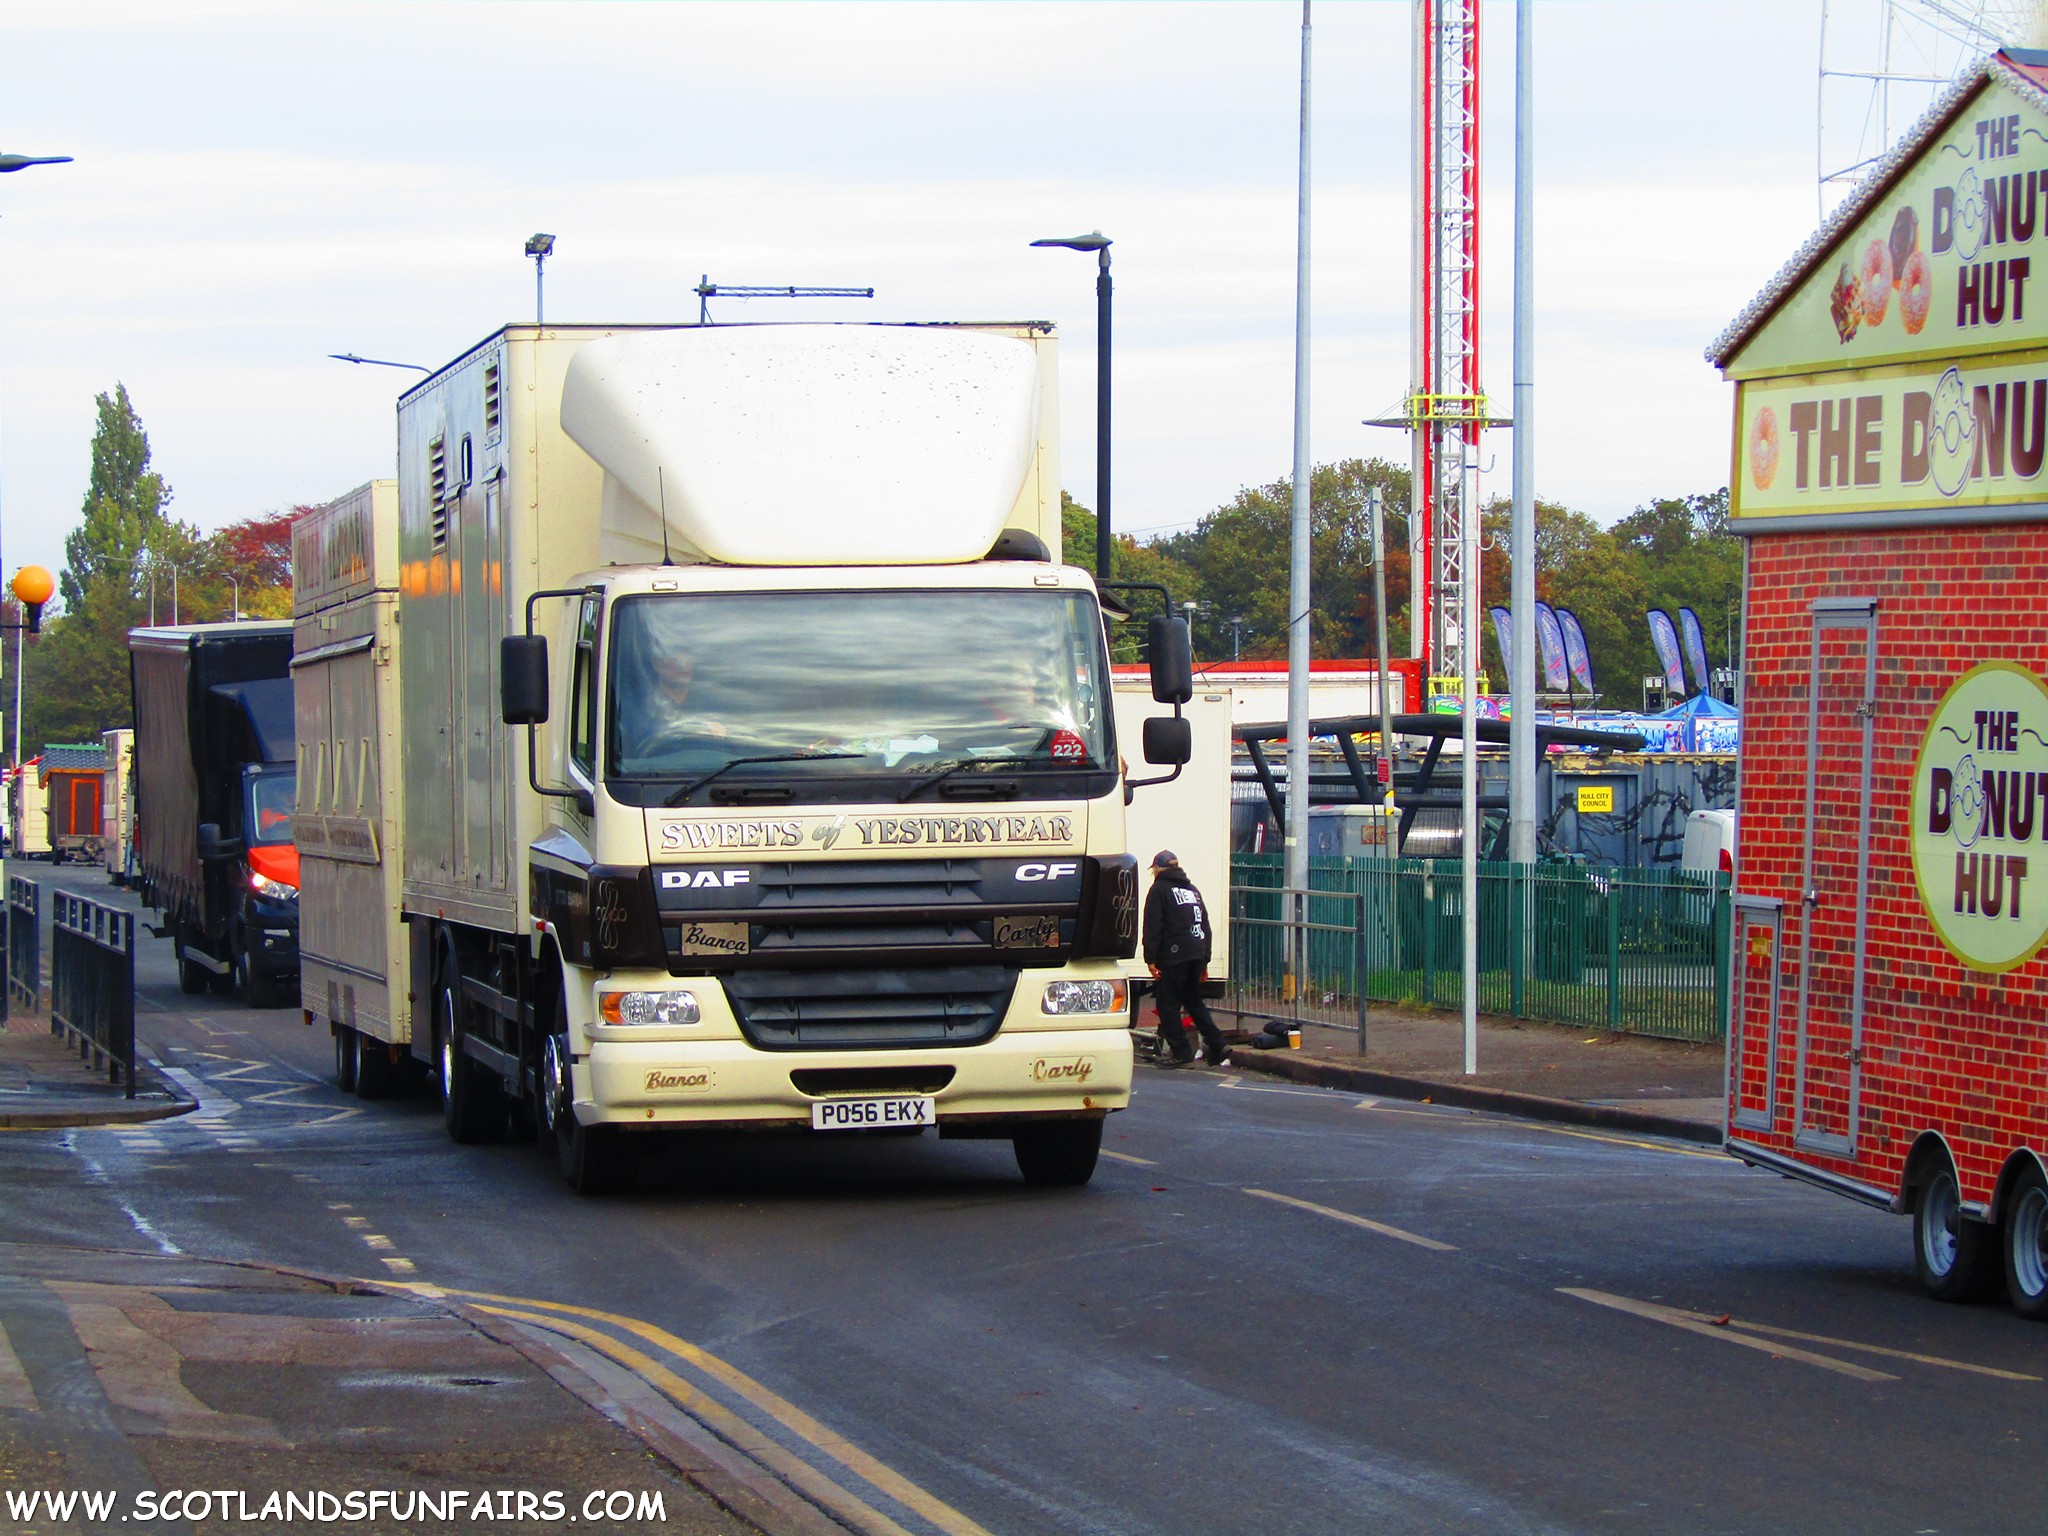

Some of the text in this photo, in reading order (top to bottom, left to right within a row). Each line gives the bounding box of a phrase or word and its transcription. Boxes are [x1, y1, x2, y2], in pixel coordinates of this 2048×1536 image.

[1975, 113, 2020, 161] THE
[1956, 256, 2031, 329] HUT
[1789, 394, 1884, 491] THE
[1973, 710, 2019, 753] THE
[1053, 744, 1082, 757] 222
[1596, 792, 1609, 800] CITY
[661, 815, 1074, 850] SWEETS of YESTERYEAR
[661, 870, 750, 888] DAF
[1014, 863, 1077, 882] CF
[1953, 851, 2028, 920] HUT
[685, 926, 747, 951] Bianca
[997, 916, 1056, 943] Carly
[646, 1070, 709, 1089] Bianca
[1034, 1057, 1093, 1083] Carly
[822, 1100, 926, 1125] PO56 EKX
